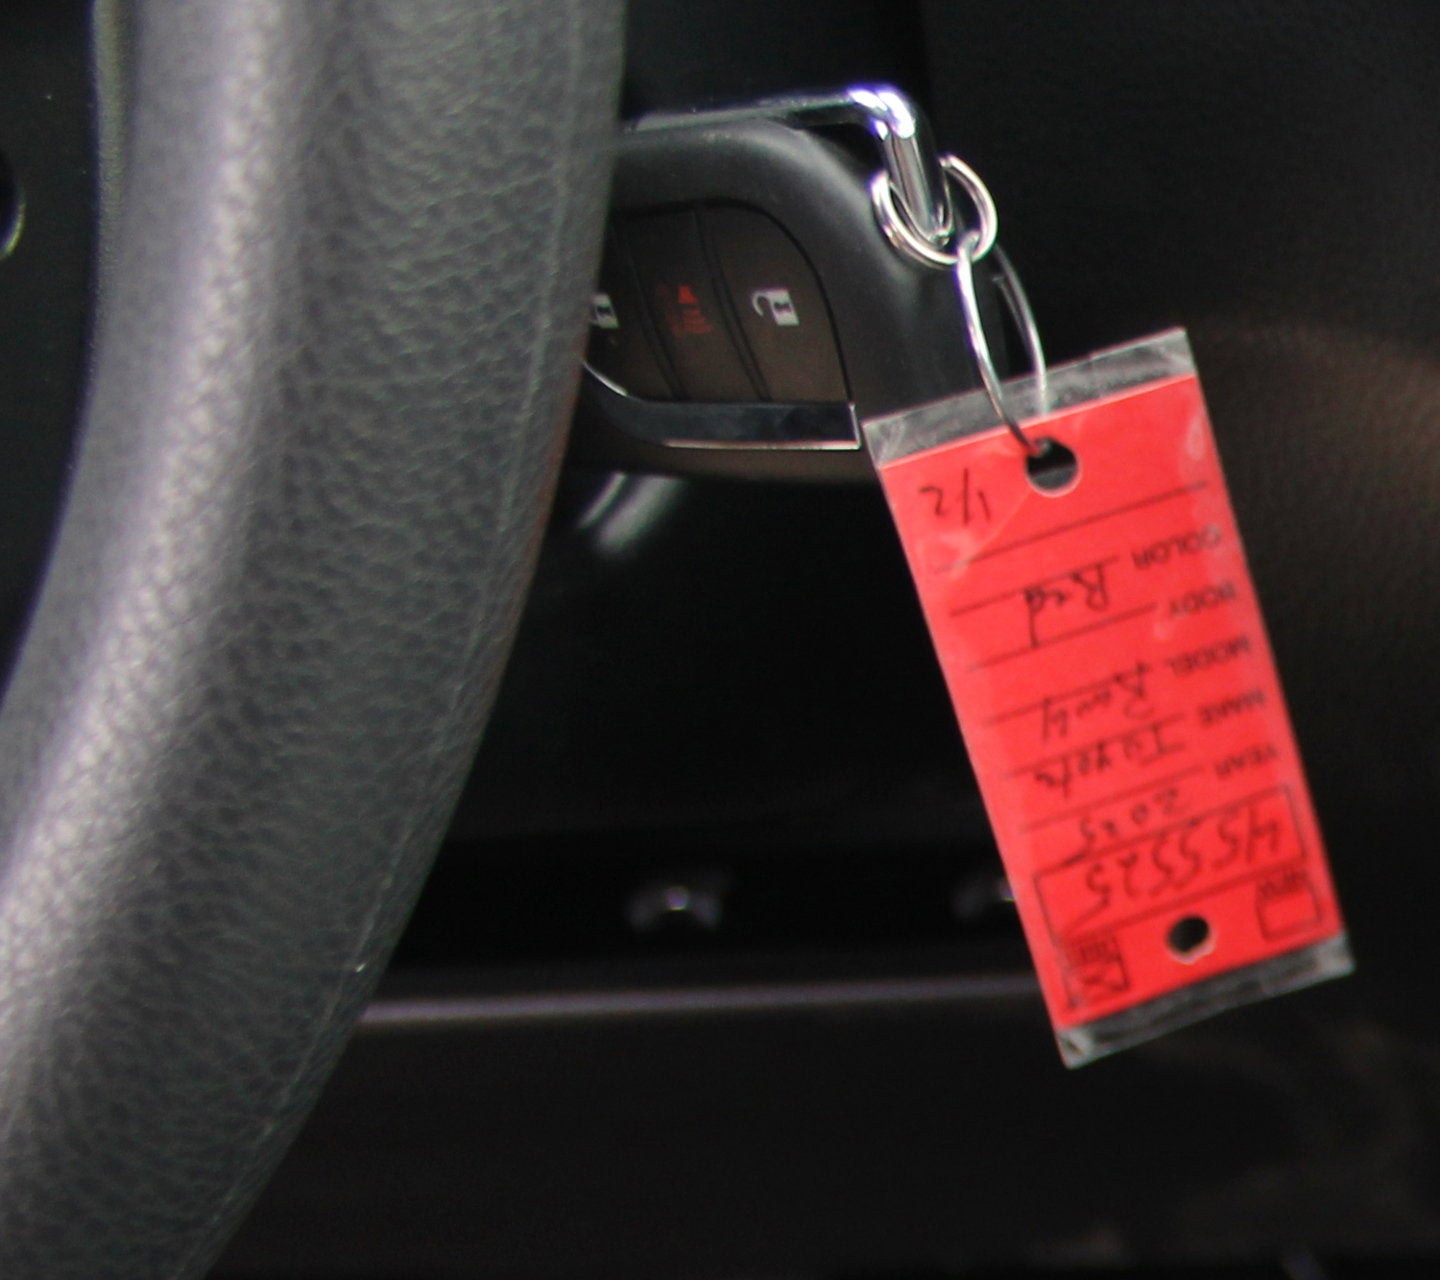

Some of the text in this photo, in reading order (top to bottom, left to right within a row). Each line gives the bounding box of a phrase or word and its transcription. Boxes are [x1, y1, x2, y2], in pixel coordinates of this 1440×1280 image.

[1132, 524, 1223, 570] COLOR
[1165, 579, 1236, 619] BODY
[1165, 633, 1251, 678] MODEL
[1196, 688, 1267, 728] MAKE
[1213, 743, 1280, 780] YEAR
